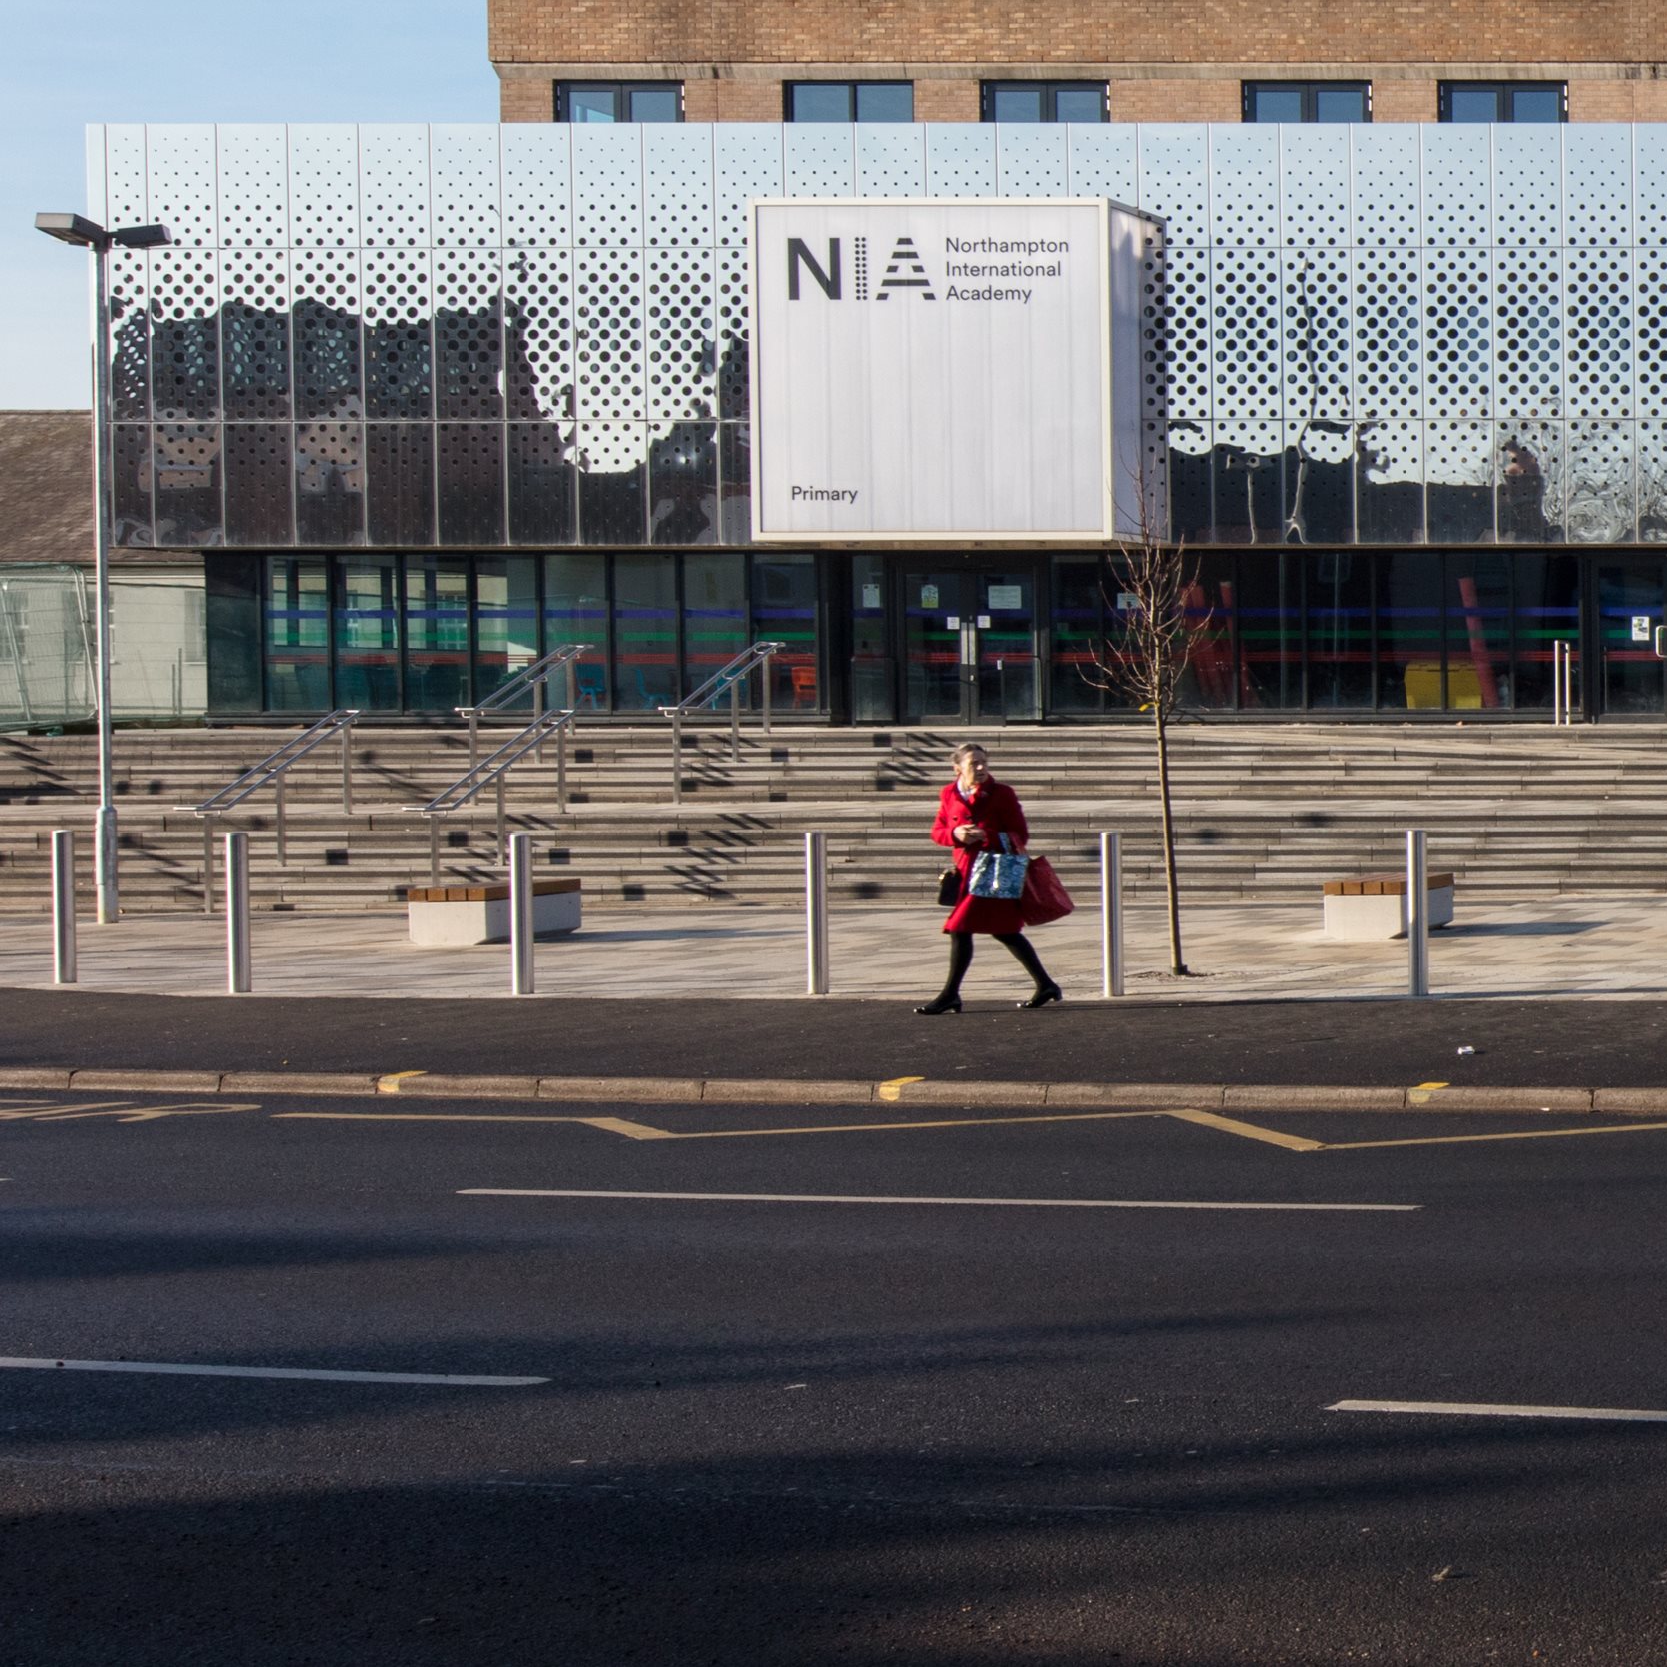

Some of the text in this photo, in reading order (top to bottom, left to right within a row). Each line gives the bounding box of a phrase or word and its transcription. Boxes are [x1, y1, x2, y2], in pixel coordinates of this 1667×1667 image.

[946, 237, 1069, 256] Northampton
[787, 237, 936, 301] NIA
[946, 261, 1061, 277] International
[946, 285, 1032, 304] Academy
[791, 485, 858, 504] Primary
